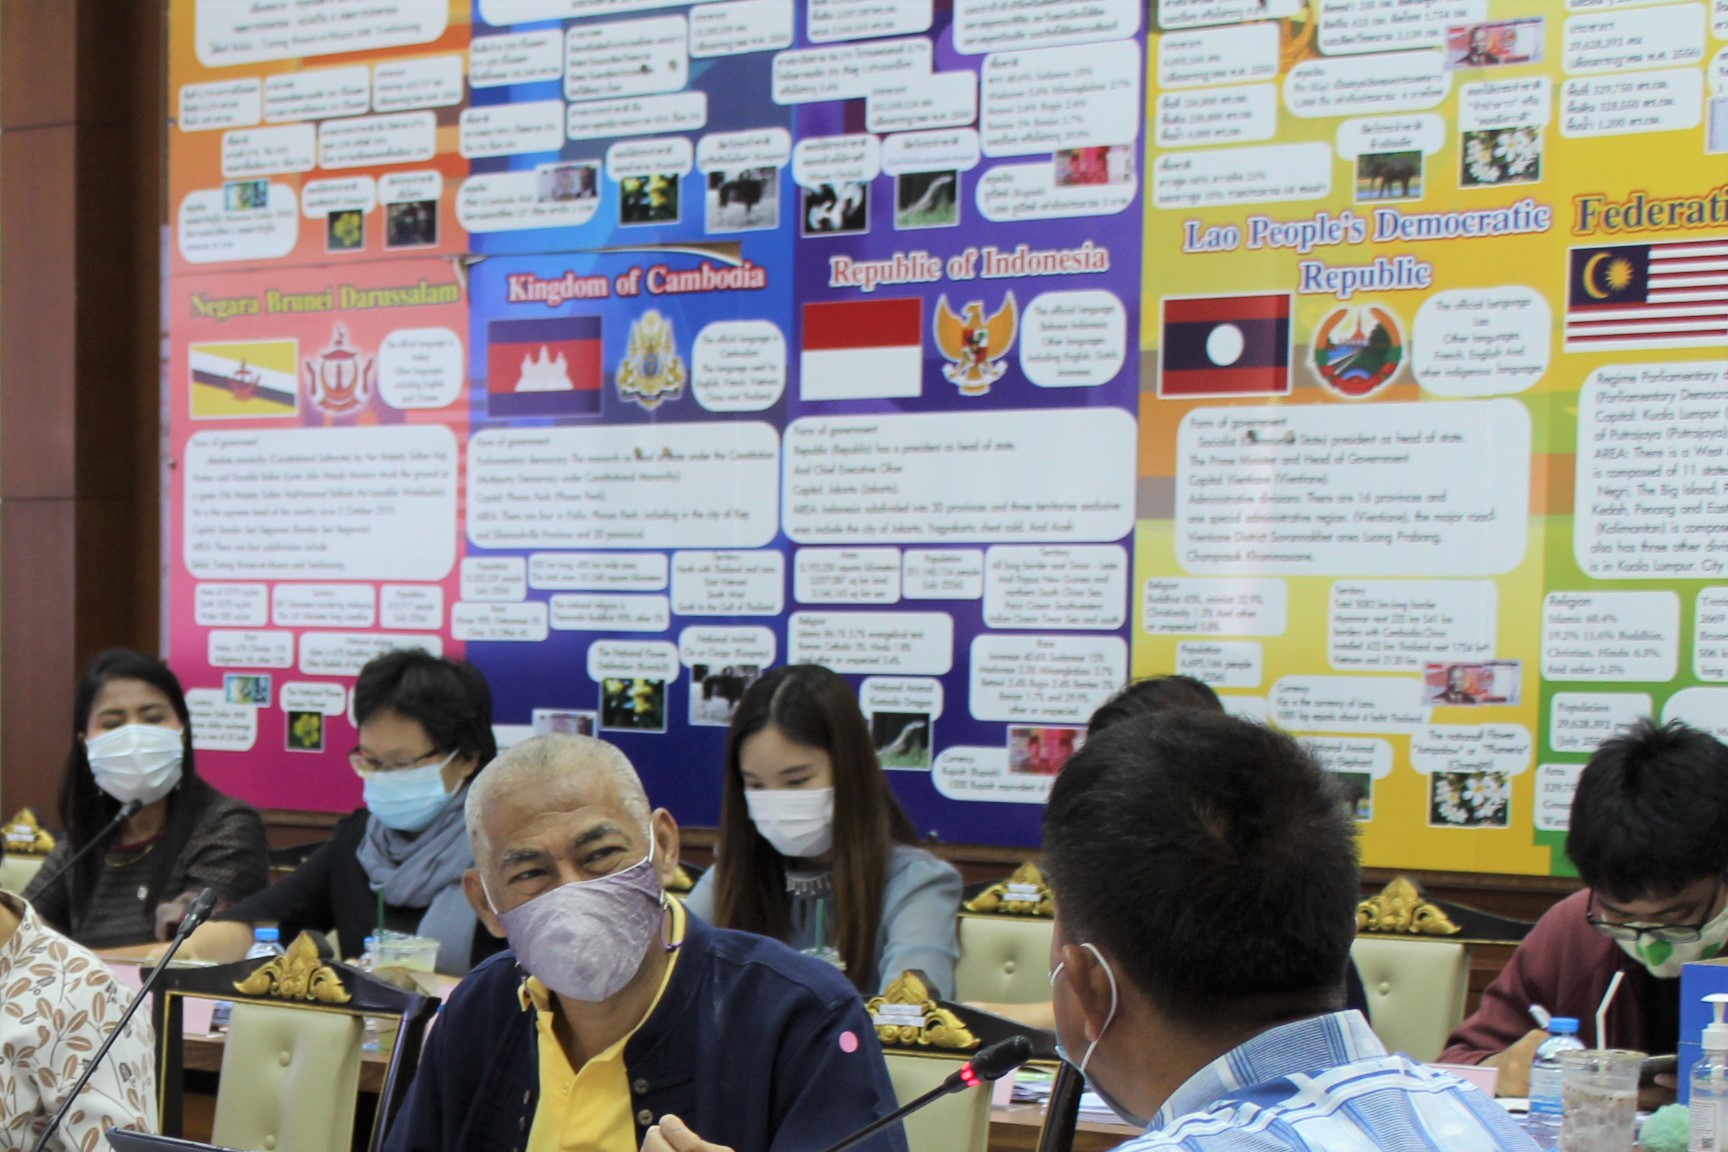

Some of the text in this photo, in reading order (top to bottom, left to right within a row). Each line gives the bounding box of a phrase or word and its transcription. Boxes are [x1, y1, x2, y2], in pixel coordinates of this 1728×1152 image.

[1185, 223, 1236, 251] Lao
[1375, 200, 1549, 242] Democratic
[509, 261, 764, 306] Kingdom of Cambodia
[831, 242, 1109, 291] Republic of Indonesia
[1301, 258, 1431, 297] Republic
[191, 282, 459, 319] Negara Brunei Darussalam
